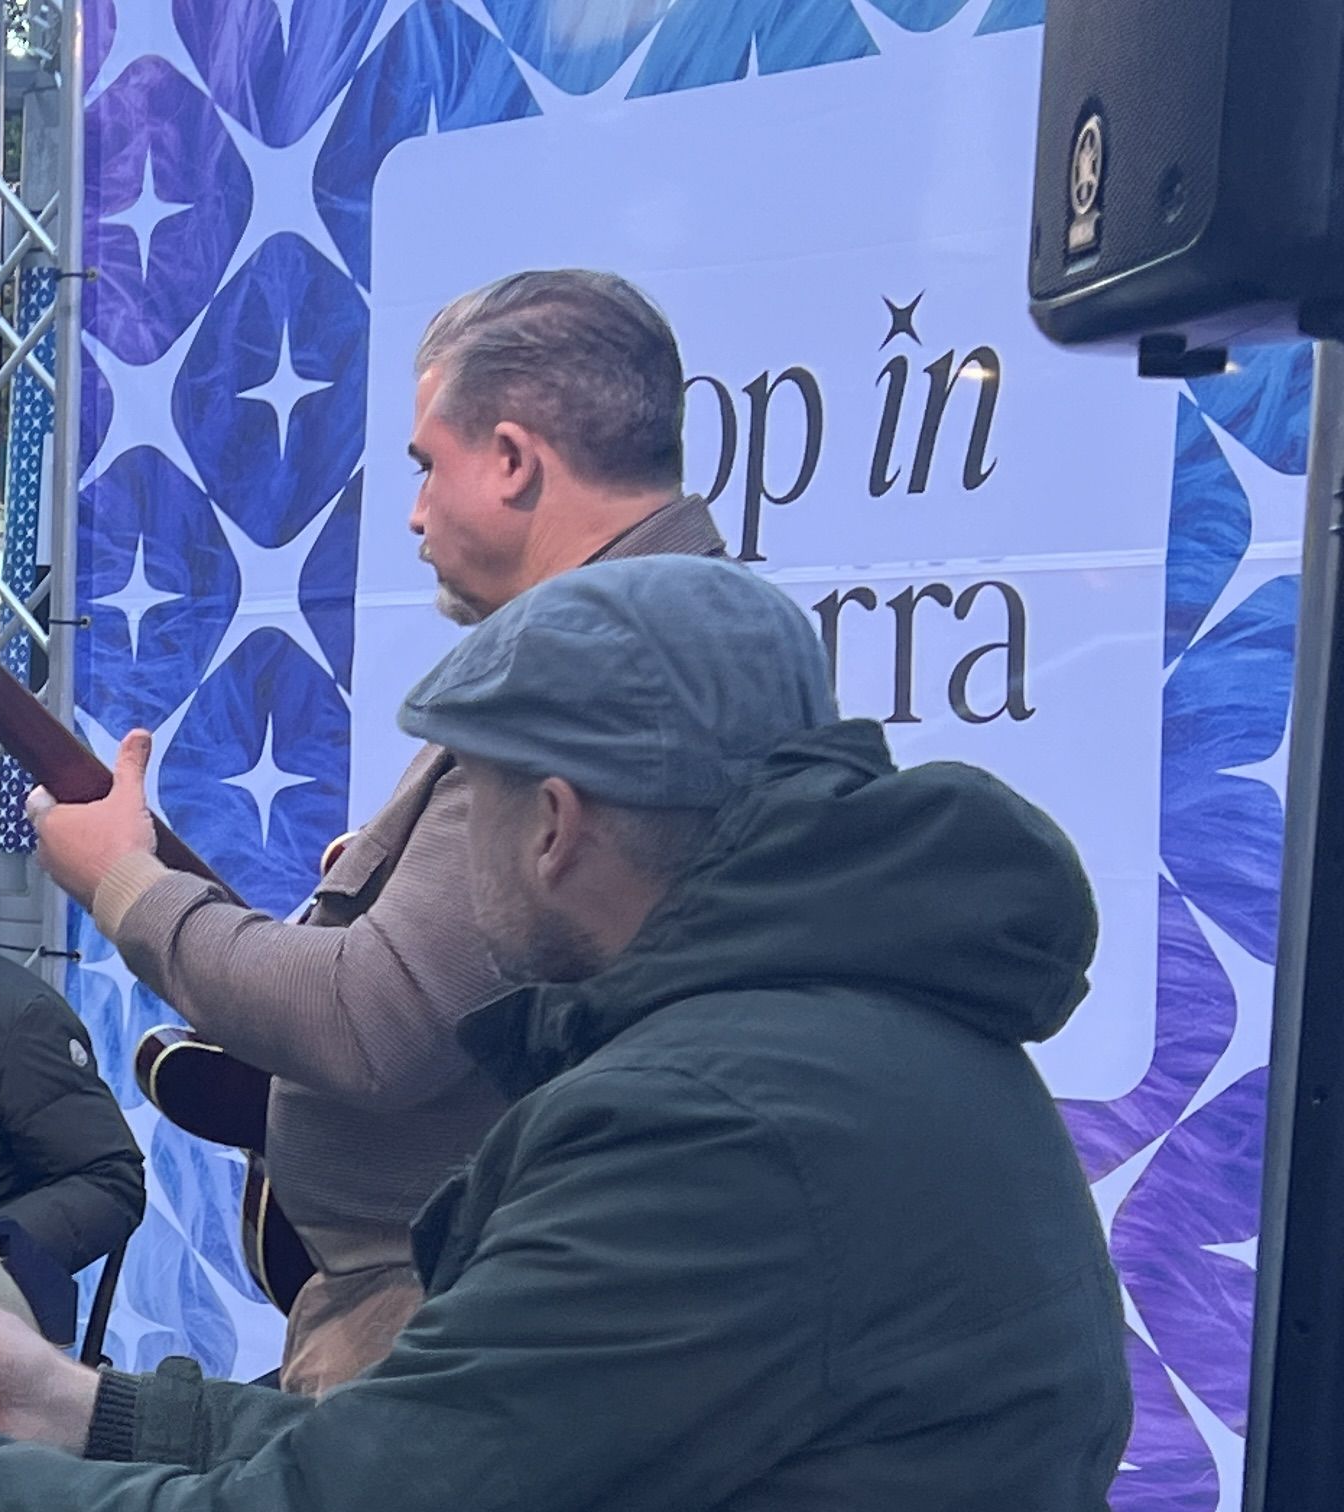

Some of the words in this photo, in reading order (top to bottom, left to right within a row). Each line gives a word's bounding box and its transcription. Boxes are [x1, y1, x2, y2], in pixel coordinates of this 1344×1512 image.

[682, 364, 824, 563] op
[869, 290, 1003, 500] in
[812, 581, 1037, 725] rra
